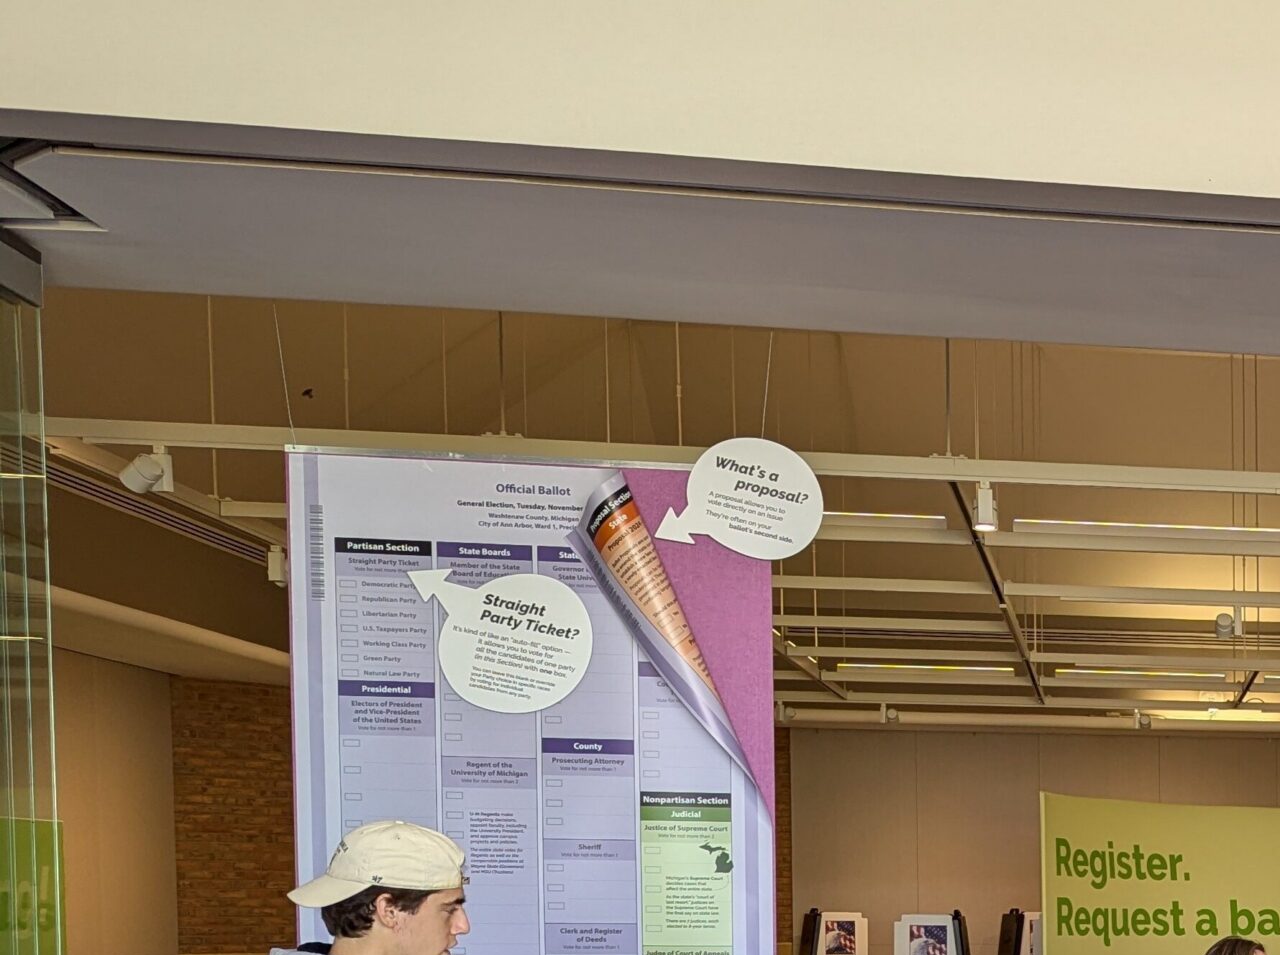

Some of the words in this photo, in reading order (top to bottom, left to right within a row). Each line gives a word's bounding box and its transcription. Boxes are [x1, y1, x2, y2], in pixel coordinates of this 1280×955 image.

[716, 456, 766, 478] What's
[769, 472, 779, 482] a
[496, 484, 535, 494] Official
[538, 485, 571, 496] Ballot
[734, 480, 809, 504] proposal?
[457, 500, 484, 508] General
[486, 501, 515, 509] Election,
[517, 503, 546, 511] Tuesday,
[715, 493, 743, 504] proposal
[744, 500, 764, 509] allows
[723, 502, 747, 514] directly
[767, 512, 783, 521] issue
[526, 514, 548, 522] County,
[590, 506, 610, 533] Proposal
[608, 514, 628, 530] State
[706, 510, 729, 520] They're
[730, 516, 747, 524] often
[757, 522, 772, 530] your
[729, 523, 752, 534] ballot's
[754, 529, 777, 540] second
[779, 535, 793, 544] side.
[347, 542, 383, 552] Partisan
[386, 544, 419, 553] Section
[459, 547, 481, 556] State
[483, 548, 511, 557] Boards
[348, 558, 375, 566] Straight
[377, 559, 396, 567] Party
[483, 594, 546, 617] Straight
[362, 610, 398, 618] Libertarian
[400, 612, 417, 620] Party
[480, 610, 522, 632] Party
[526, 618, 580, 640] Ticket?
[376, 626, 409, 634] Taxpayers
[410, 627, 427, 635] Party
[363, 641, 390, 649] Working
[384, 656, 401, 664] Party
[404, 671, 420, 679] Party
[362, 685, 411, 694] Presidential
[368, 708, 420, 716] Vice-President
[574, 742, 602, 751] County
[466, 761, 491, 769] Regent
[552, 757, 593, 765] Prosecuting
[594, 758, 624, 766] Attorney
[451, 769, 486, 777] University
[497, 770, 528, 778] Michigan
[643, 795, 695, 805] Nonpartisan
[697, 796, 728, 805] Section
[671, 810, 701, 818] Judicial
[644, 824, 668, 832] Justice
[678, 825, 707, 833] Supreme
[1055, 837, 1191, 890] Register.
[1056, 896, 1185, 947] Request
[1195, 908, 1218, 936] a
[594, 928, 622, 936] Register
